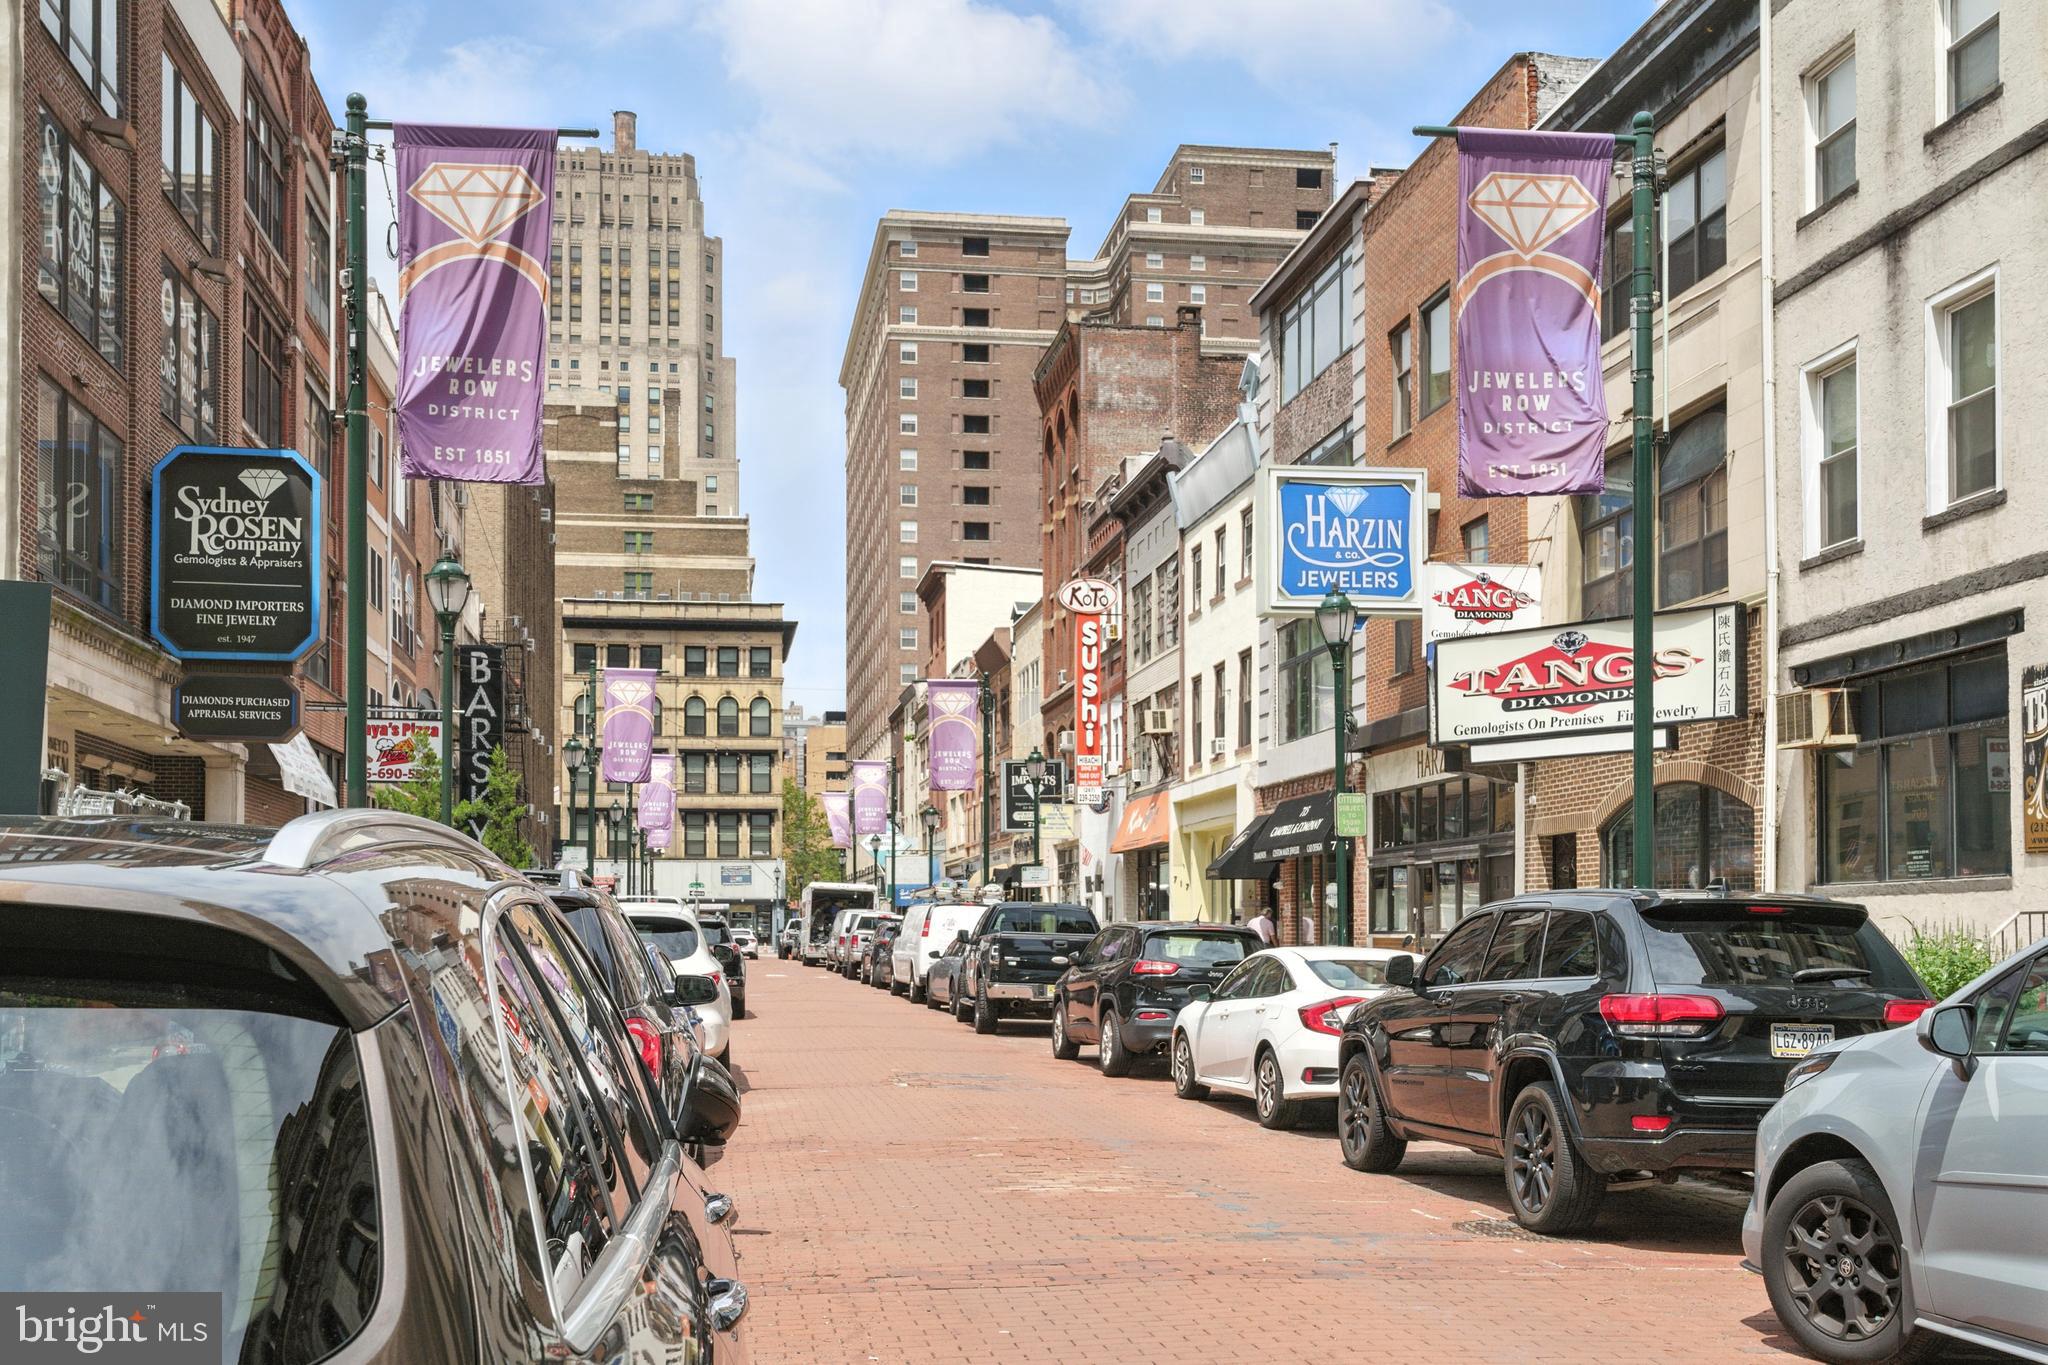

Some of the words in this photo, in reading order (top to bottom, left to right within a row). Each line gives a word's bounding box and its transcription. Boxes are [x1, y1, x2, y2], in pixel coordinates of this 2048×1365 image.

[413, 356, 532, 383] JEWELERS
[449, 378, 498, 397] ROW
[1469, 370, 1586, 393] JEWELERS
[1502, 394, 1551, 411] ROW
[428, 403, 520, 421] DISTRICT
[1484, 421, 1573, 434] DISTRICT
[434, 446, 465, 462] EST
[476, 449, 511, 464] 1851
[1489, 464, 1519, 478] EST
[1531, 462, 1567, 477] 1851
[174, 485, 270, 521] Sydney
[1303, 494, 1403, 550] HARZIN
[188, 513, 303, 556] ROSEN
[209, 534, 303, 559] Company
[1335, 551, 1343, 559] &
[1345, 551, 1361, 559] CO.
[174, 553, 237, 568] Gemologists
[239, 556, 248, 566] &
[249, 556, 303, 569] Appraisers
[1296, 569, 1399, 589] JEWELERS
[170, 598, 234, 611] DIAMOND
[235, 599, 305, 613] IMPORTERS
[196, 613, 224, 625] FINE
[225, 614, 278, 627] JEWELRY
[1456, 611, 1512, 619] DIAMONDS
[217, 635, 232, 643] est.
[237, 635, 257, 644] 1947
[1717, 613, 1731, 715] 陳氏鑽石公司
[181, 695, 234, 706] DIAMONDS
[235, 697, 290, 708] PURCHASED
[187, 709, 238, 719] APPRAISAL
[239, 710, 282, 721] SERVICES
[1453, 717, 1525, 737] Gemologists
[1528, 716, 1547, 730] On
[1550, 712, 1606, 729] Premises
[1616, 709, 1634, 723] Fi
[1655, 704, 1700, 719] ewelry
[464, 650, 497, 846] BARSKY
[608, 741, 649, 751] JEWELERS
[934, 751, 972, 759] JEWELERS
[1011, 775, 1057, 787] IMPTS
[1787, 994, 1826, 1014] Jeep
